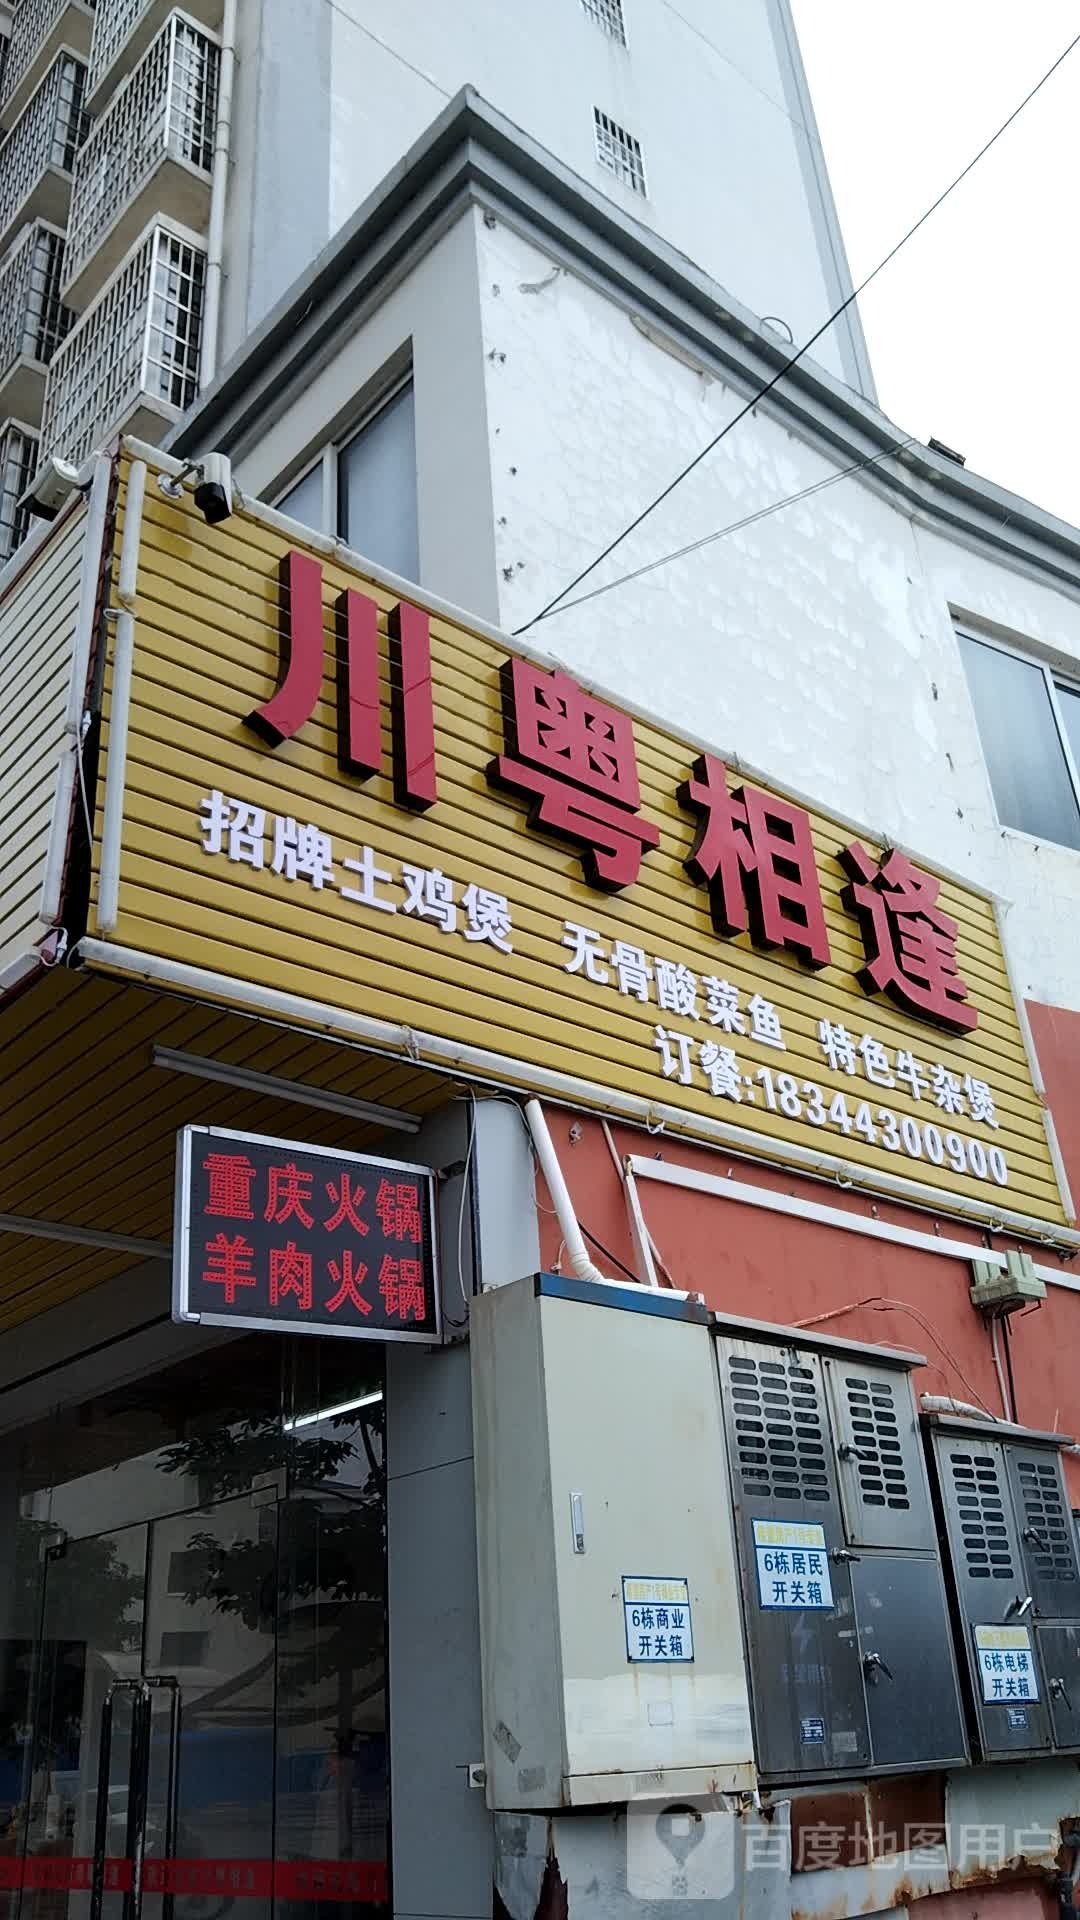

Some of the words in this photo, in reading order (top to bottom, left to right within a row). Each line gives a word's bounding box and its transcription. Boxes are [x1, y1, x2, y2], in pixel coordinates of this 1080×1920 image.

[246, 551, 979, 1034] 川粤相逢
[200, 789, 513, 953] 招牌土鸡煲
[562, 920, 786, 1050] 无骨酸菜鱼
[817, 1018, 999, 1129] 特色牛杂煲
[202, 1152, 423, 1243] 重庆火锅
[202, 1232, 426, 1321] 羊肉火锅
[764, 1551, 823, 1575] 6栋居民
[772, 1581, 822, 1604] 开关箱
[632, 1607, 685, 1629] 6栋商业
[639, 1634, 683, 1656] 开关箱
[984, 1653, 1029, 1672] 6栋电梯
[992, 1678, 1029, 1697] 开关箱
